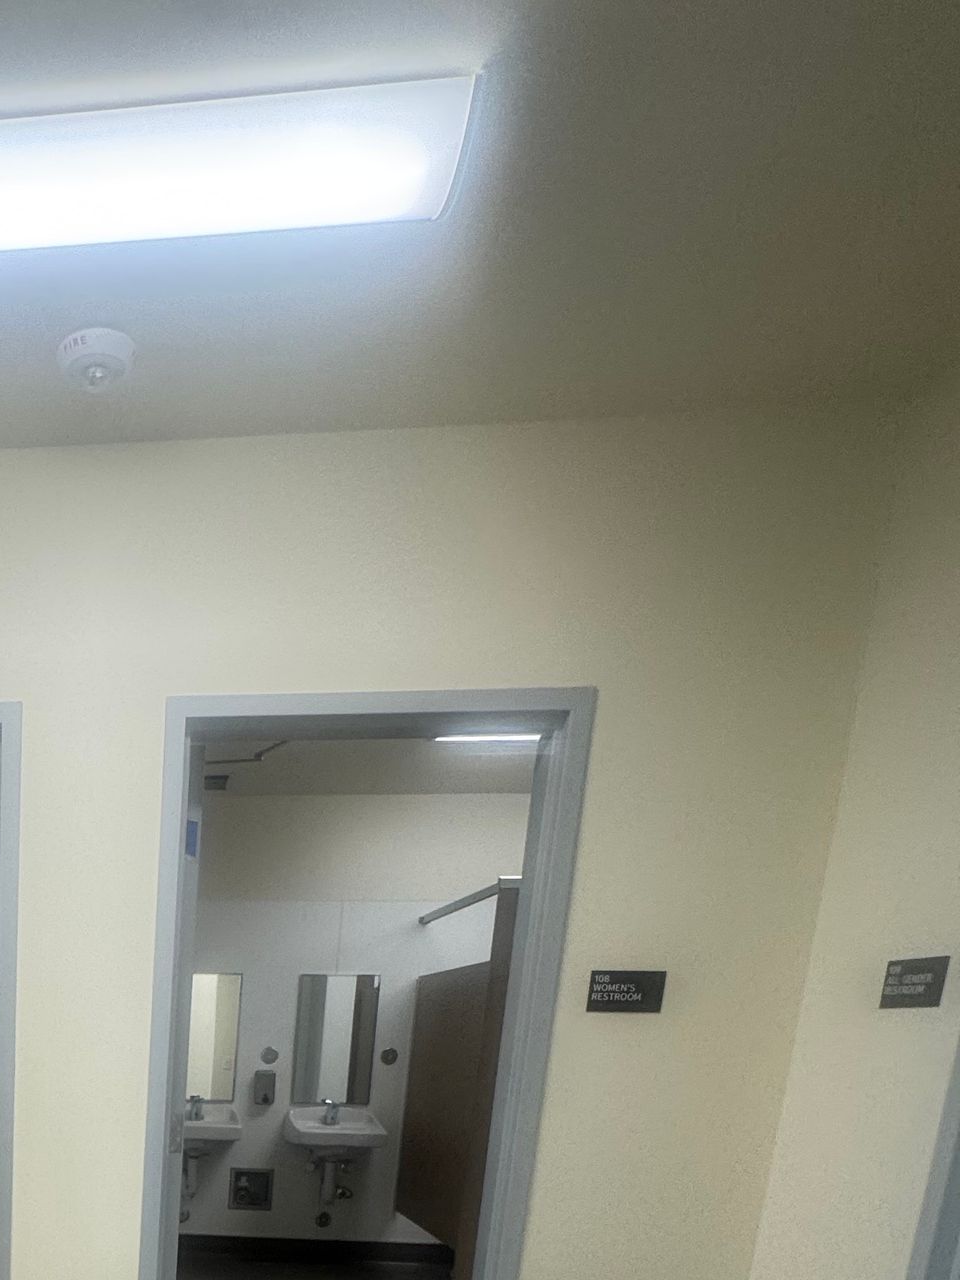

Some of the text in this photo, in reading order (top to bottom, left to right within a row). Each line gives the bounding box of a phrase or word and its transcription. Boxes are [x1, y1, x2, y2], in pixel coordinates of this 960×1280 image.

[594, 975, 610, 983] 108
[593, 983, 636, 992] WOMEN'S
[591, 992, 642, 1001] RESTROOM
